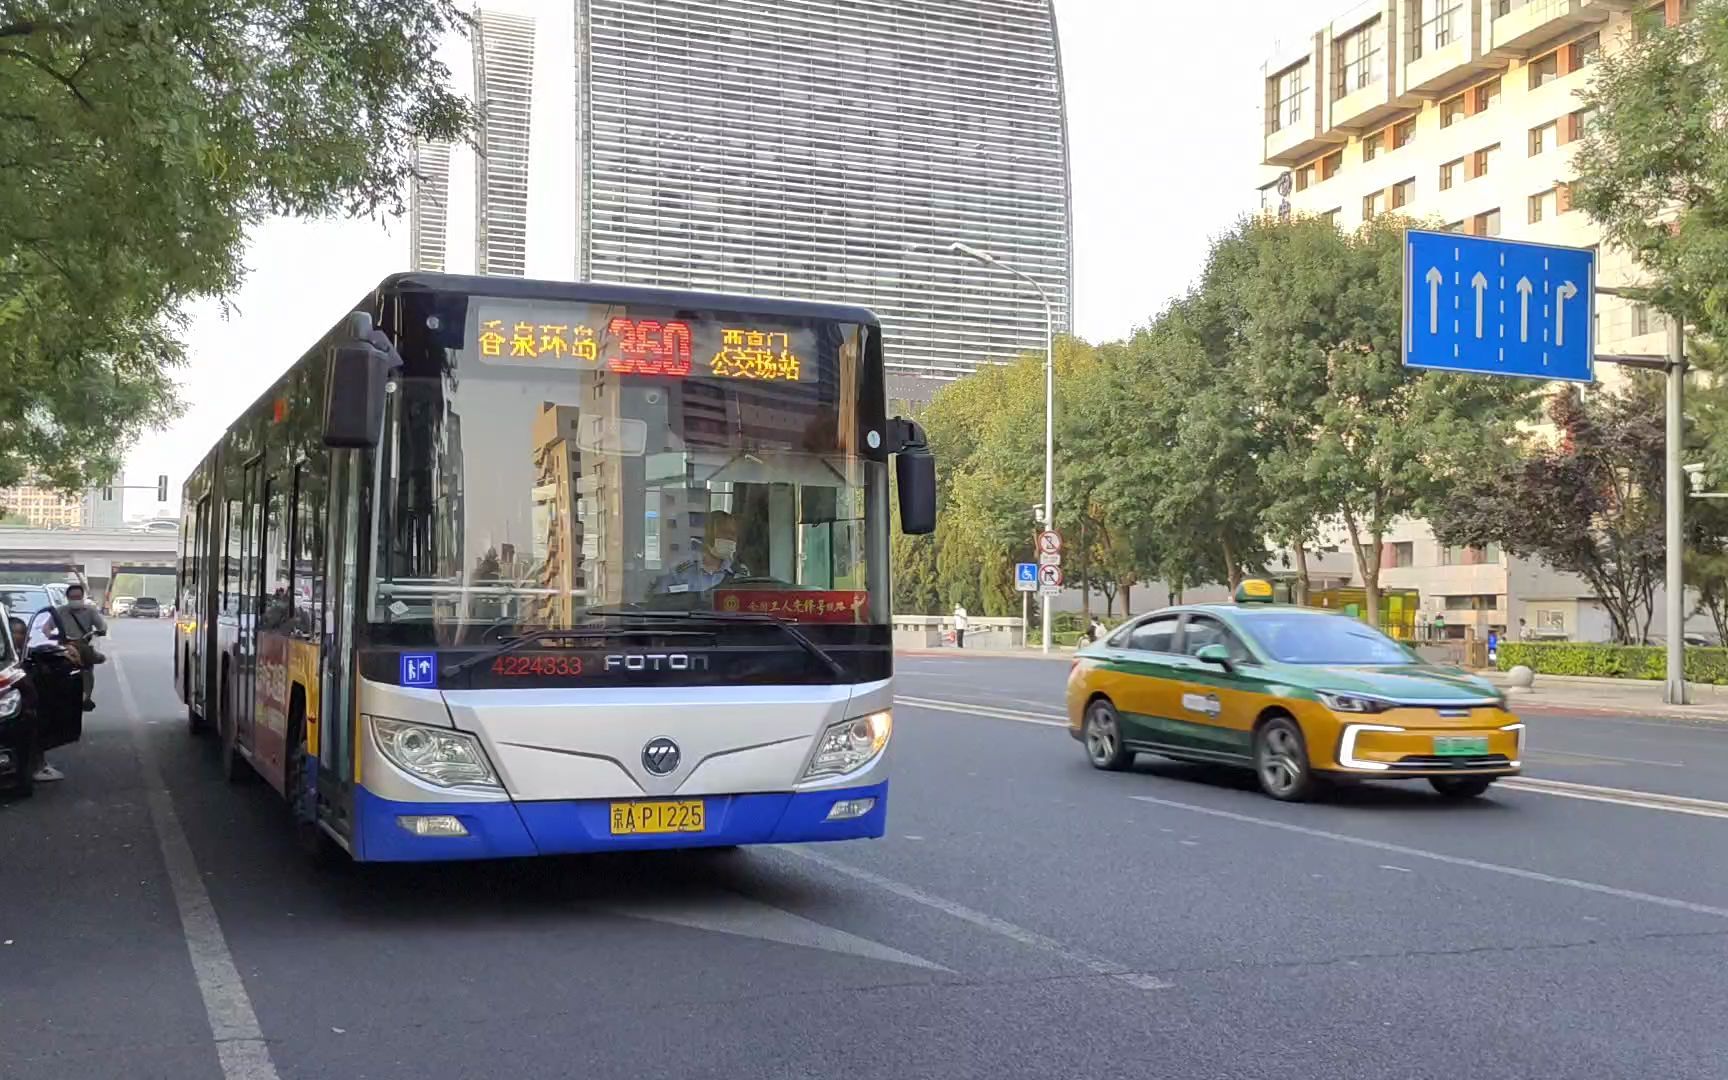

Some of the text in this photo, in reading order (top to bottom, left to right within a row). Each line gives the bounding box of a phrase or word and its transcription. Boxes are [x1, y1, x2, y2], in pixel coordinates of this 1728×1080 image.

[478, 319, 598, 361] 香泉环岛
[608, 318, 690, 376] 360
[720, 328, 789, 356] 西直门
[710, 352, 801, 381] 公交场站
[491, 655, 584, 677] 4224333
[603, 654, 709, 671] FOTON
